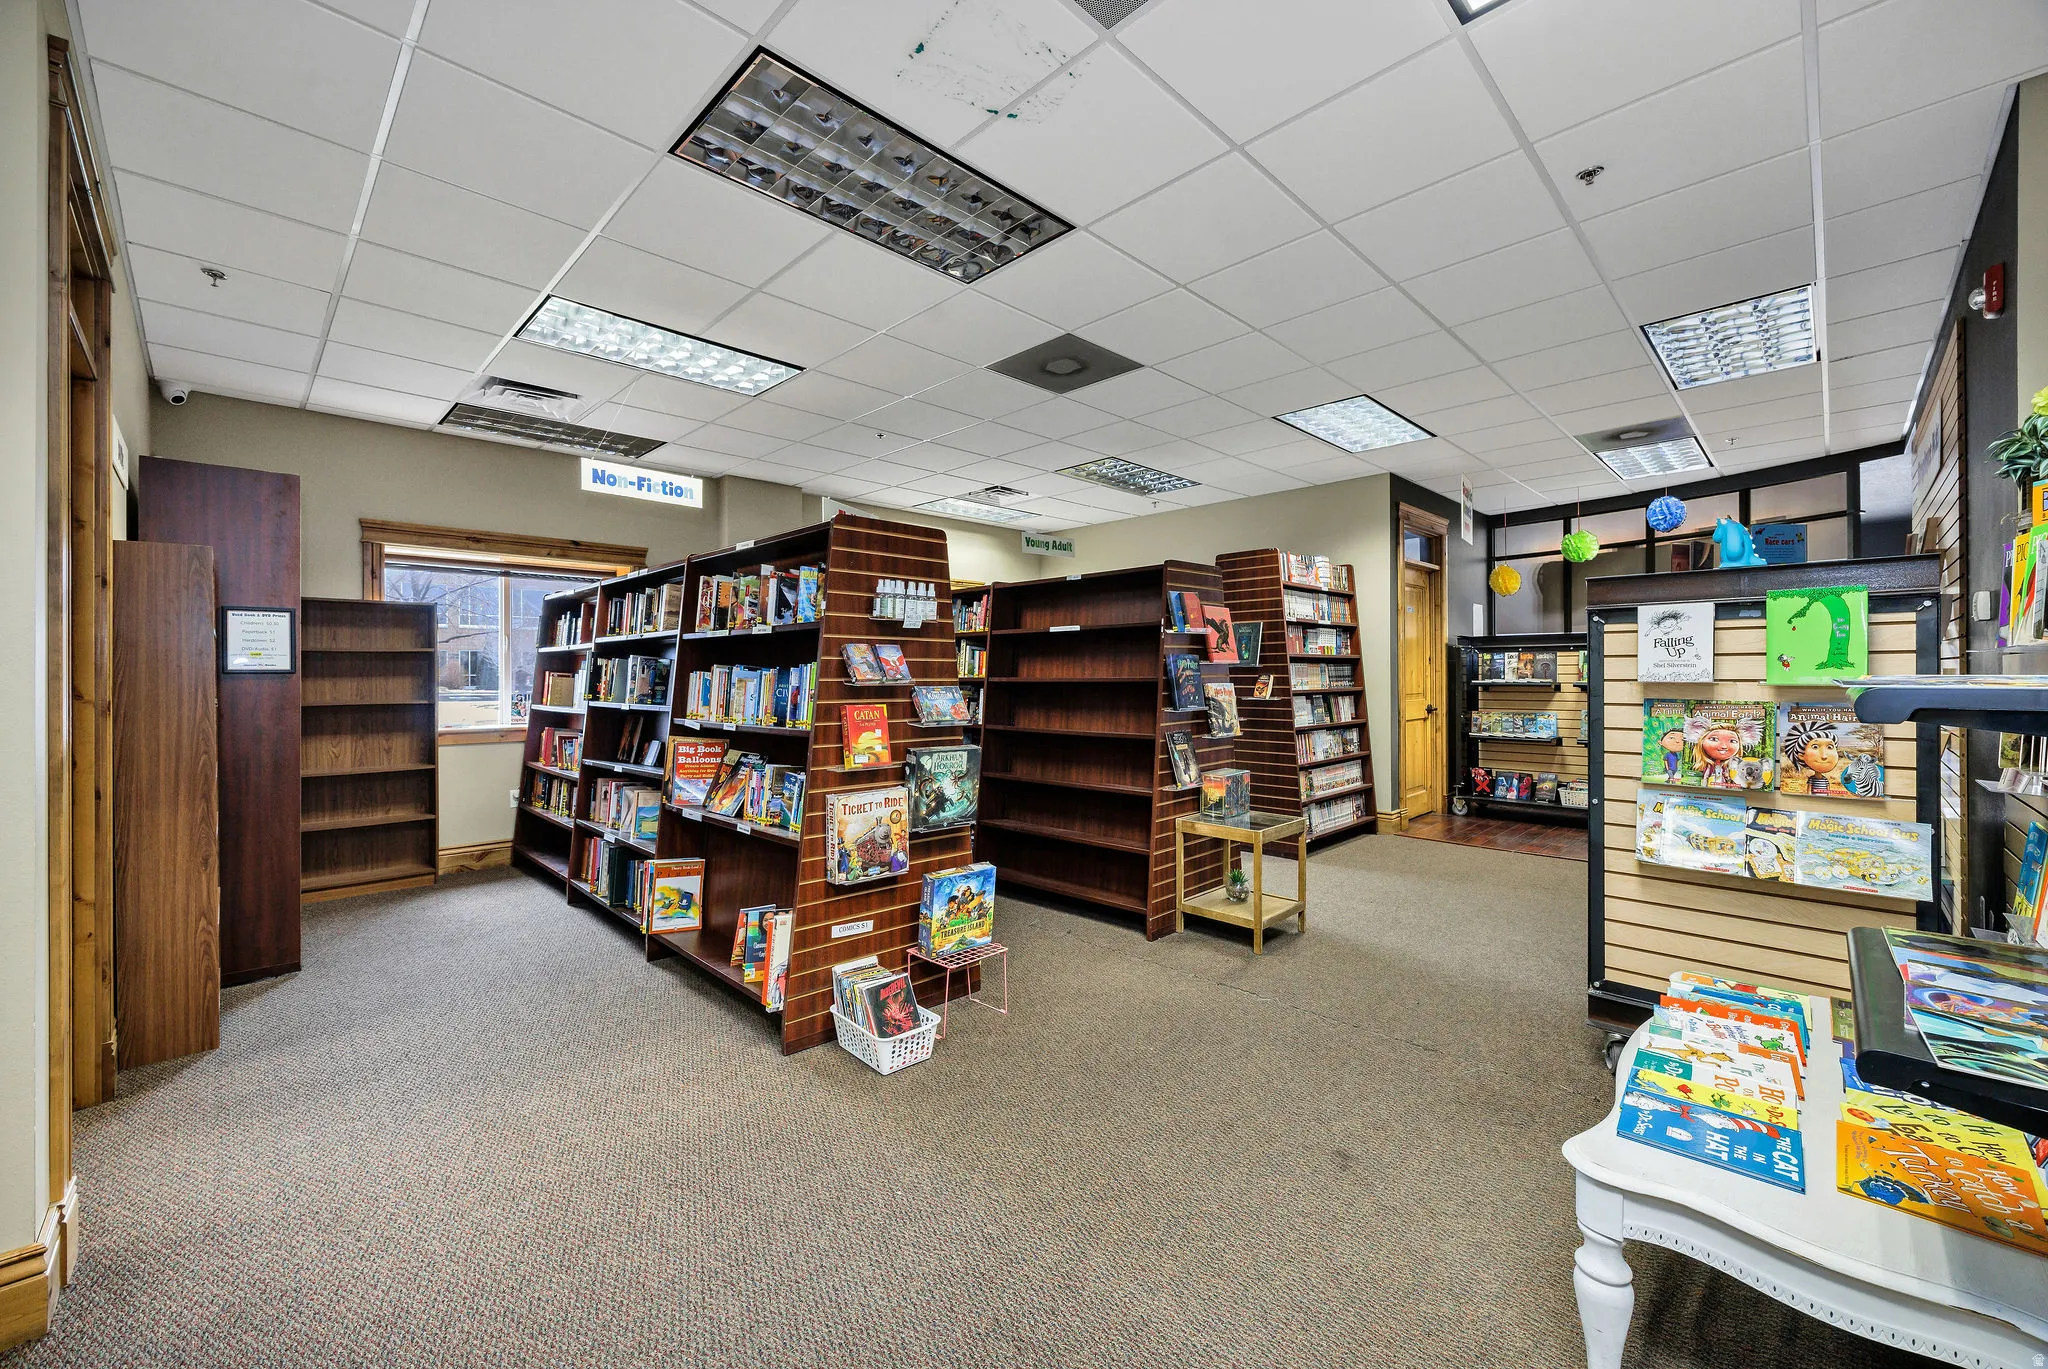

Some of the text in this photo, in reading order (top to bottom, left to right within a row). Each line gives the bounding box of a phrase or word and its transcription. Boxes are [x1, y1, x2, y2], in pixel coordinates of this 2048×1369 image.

[591, 468, 694, 500] Non-Fiction
[1025, 536, 1073, 552] Young Adult
[1653, 635, 1695, 648] Falling
[1666, 647, 1686, 658] Up
[853, 710, 881, 721] CATAN
[1694, 709, 1729, 718] Animal
[1790, 713, 1830, 721] Animal
[678, 745, 722, 754] Big Book
[678, 756, 722, 764] Balloons
[936, 752, 963, 762] ARKHAM
[933, 760, 965, 772] HORROR
[841, 796, 905, 816] TICKET TO RIDE
[1705, 808, 1741, 821] School
[1808, 819, 1845, 833] Magic
[1845, 823, 1889, 838] School
[1893, 828, 1919, 842] Bus
[838, 923, 861, 934] COMICS
[940, 920, 986, 939] TREASURE ISLAND
[1774, 1136, 1792, 1152] THE
[1937, 1131, 1961, 1144] to
[1704, 1130, 1730, 1162] HAT
[1733, 1145, 1748, 1161] THE
[1969, 1139, 2017, 1166] How
[1752, 1152, 1767, 1165] IN
[1771, 1150, 1800, 1182] CAT
[1878, 1142, 1974, 1217] Turkey
[1974, 1166, 2030, 1200] How
[1944, 1155, 2035, 1232] to Catch a
